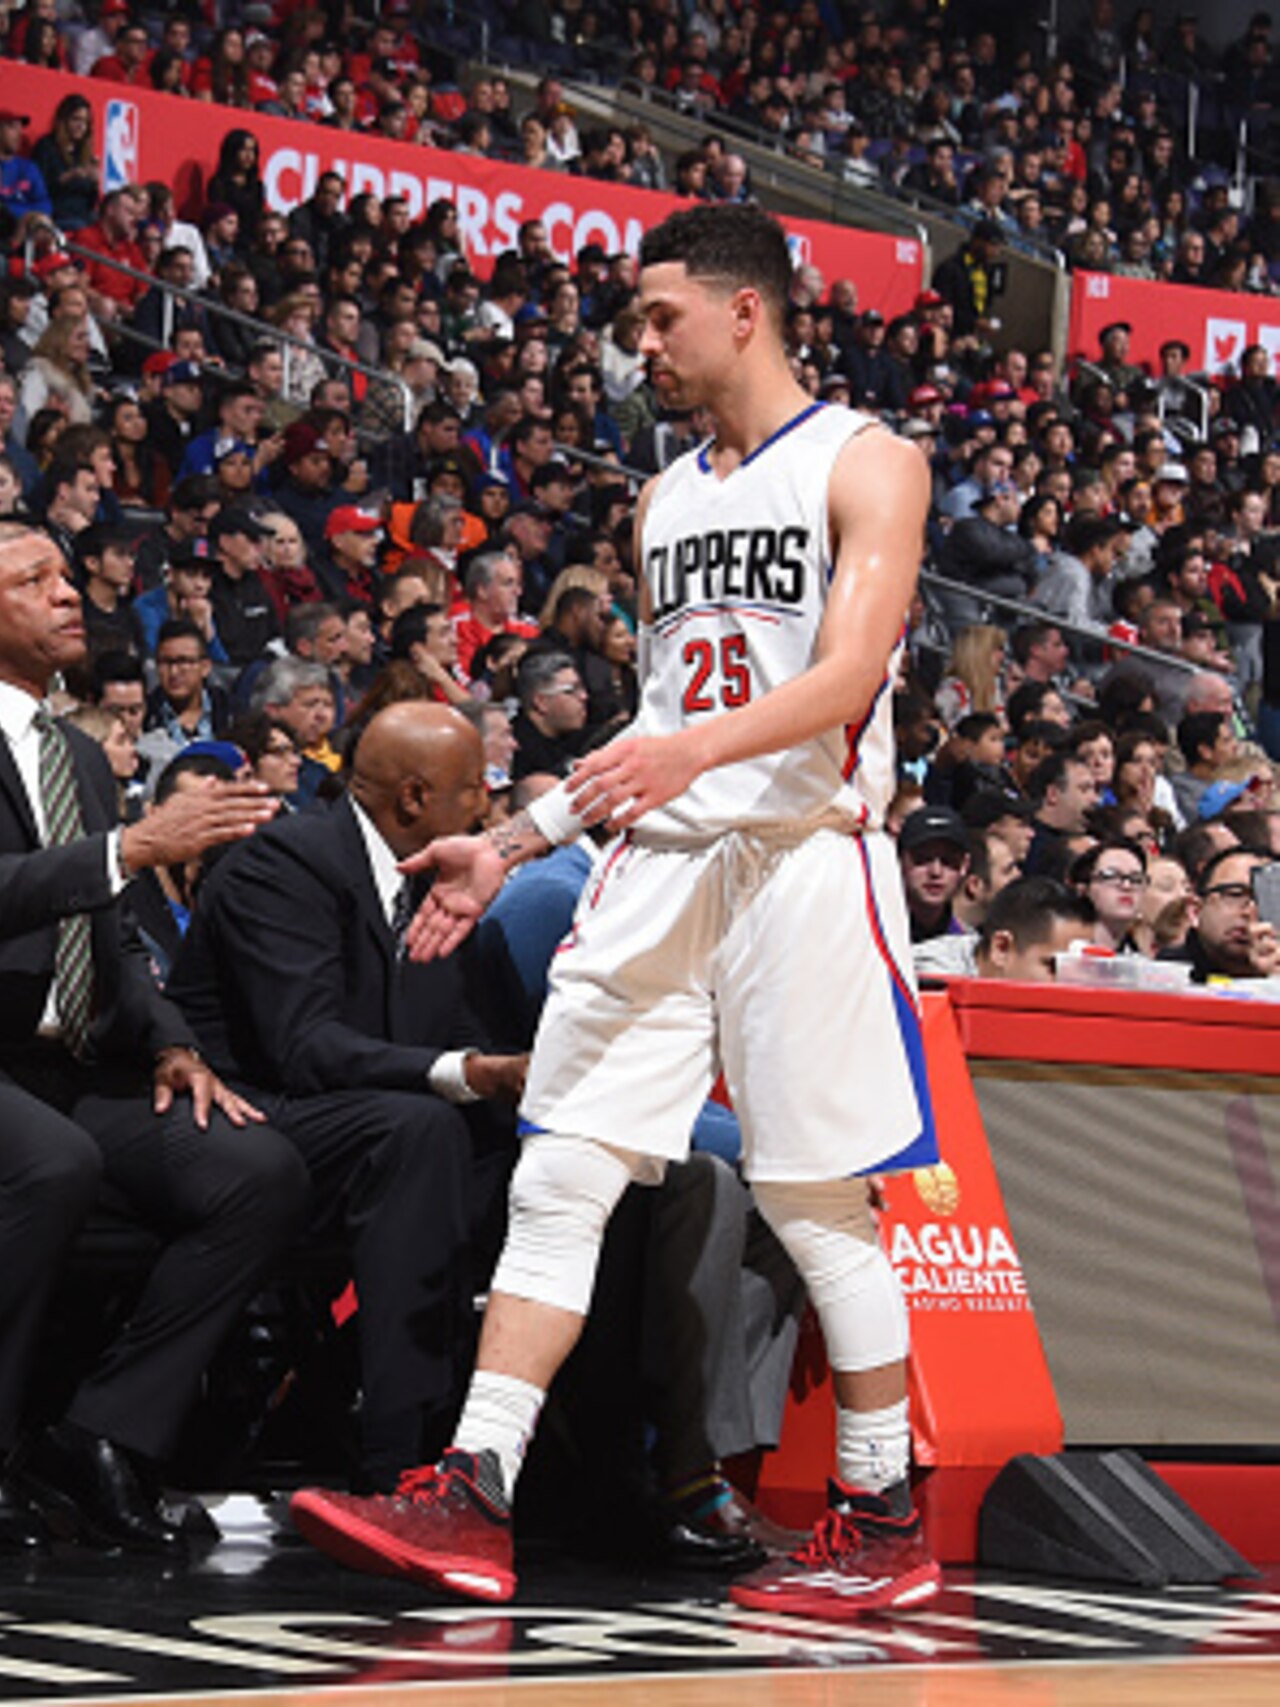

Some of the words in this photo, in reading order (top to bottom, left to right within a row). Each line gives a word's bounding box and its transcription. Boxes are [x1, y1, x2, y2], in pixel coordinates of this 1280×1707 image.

[263, 147, 642, 266] CLIPPERSCO
[681, 633, 752, 713] 25
[891, 1223, 1021, 1268] AGUA
[894, 1267, 1027, 1295] CALIENTE
